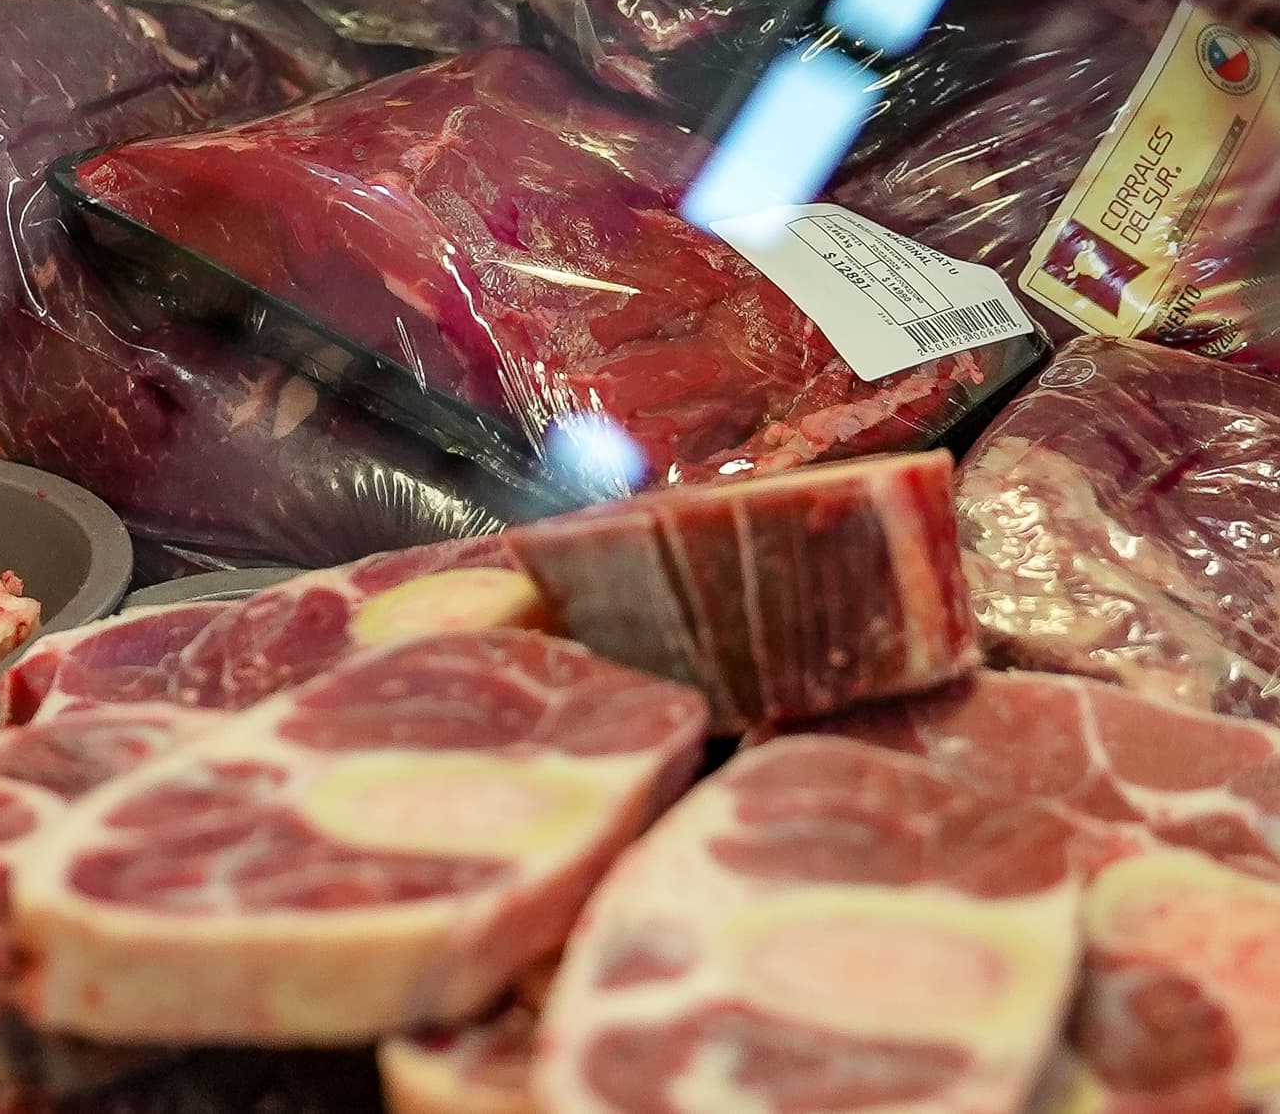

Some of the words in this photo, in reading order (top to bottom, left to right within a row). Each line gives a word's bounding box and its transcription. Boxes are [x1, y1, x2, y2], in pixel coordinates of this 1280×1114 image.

[1100, 125, 1173, 231] CORRALES
[883, 231, 932, 267] NACIONAL
[930, 249, 953, 267] CAT
[948, 268, 960, 276] U
[833, 260, 872, 290] 12891
